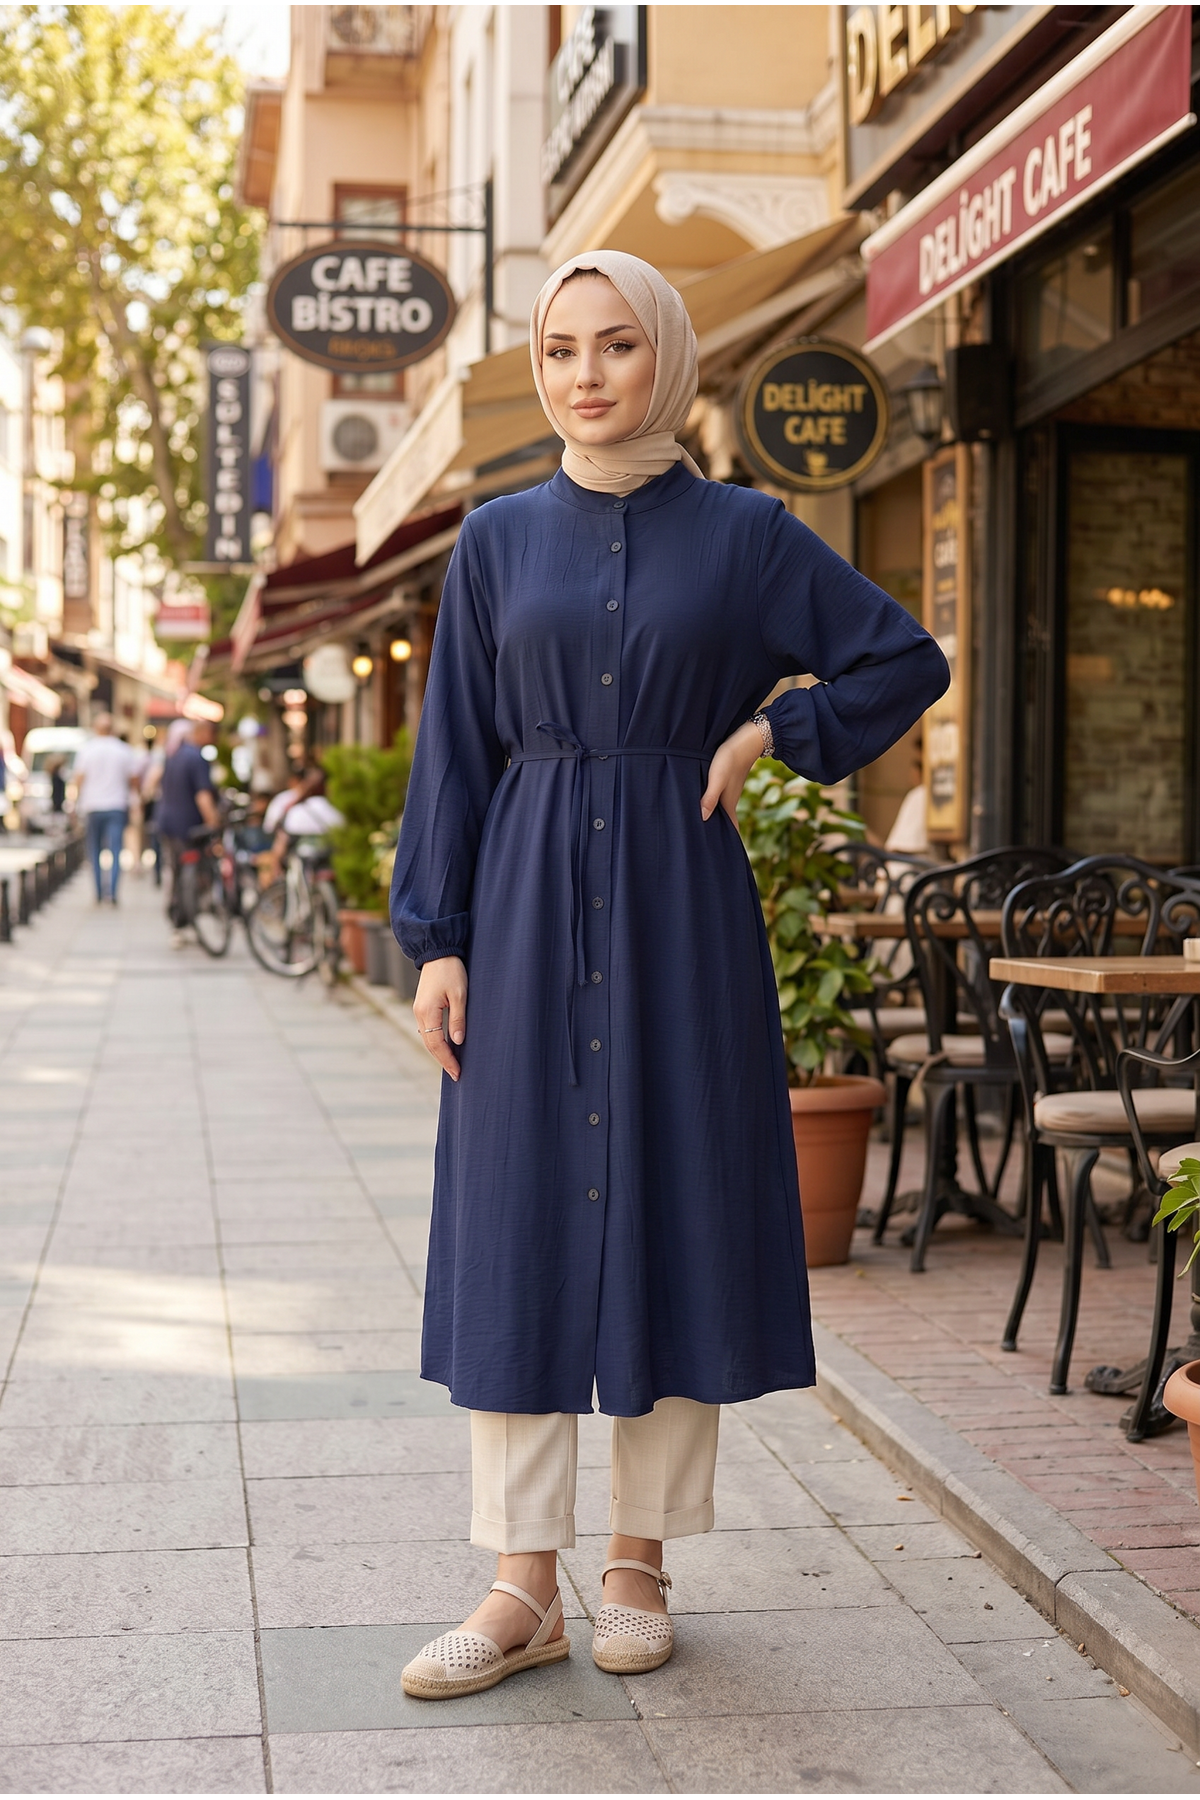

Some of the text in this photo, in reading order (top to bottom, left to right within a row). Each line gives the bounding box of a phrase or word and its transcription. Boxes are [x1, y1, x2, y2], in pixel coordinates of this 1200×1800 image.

[919, 103, 1093, 296] DELİGHT CAFE
[311, 255, 413, 293] CAFE
[291, 291, 433, 334] BİSTRO
[762, 378, 868, 413] DELİGHT
[783, 415, 848, 445] CAFE
